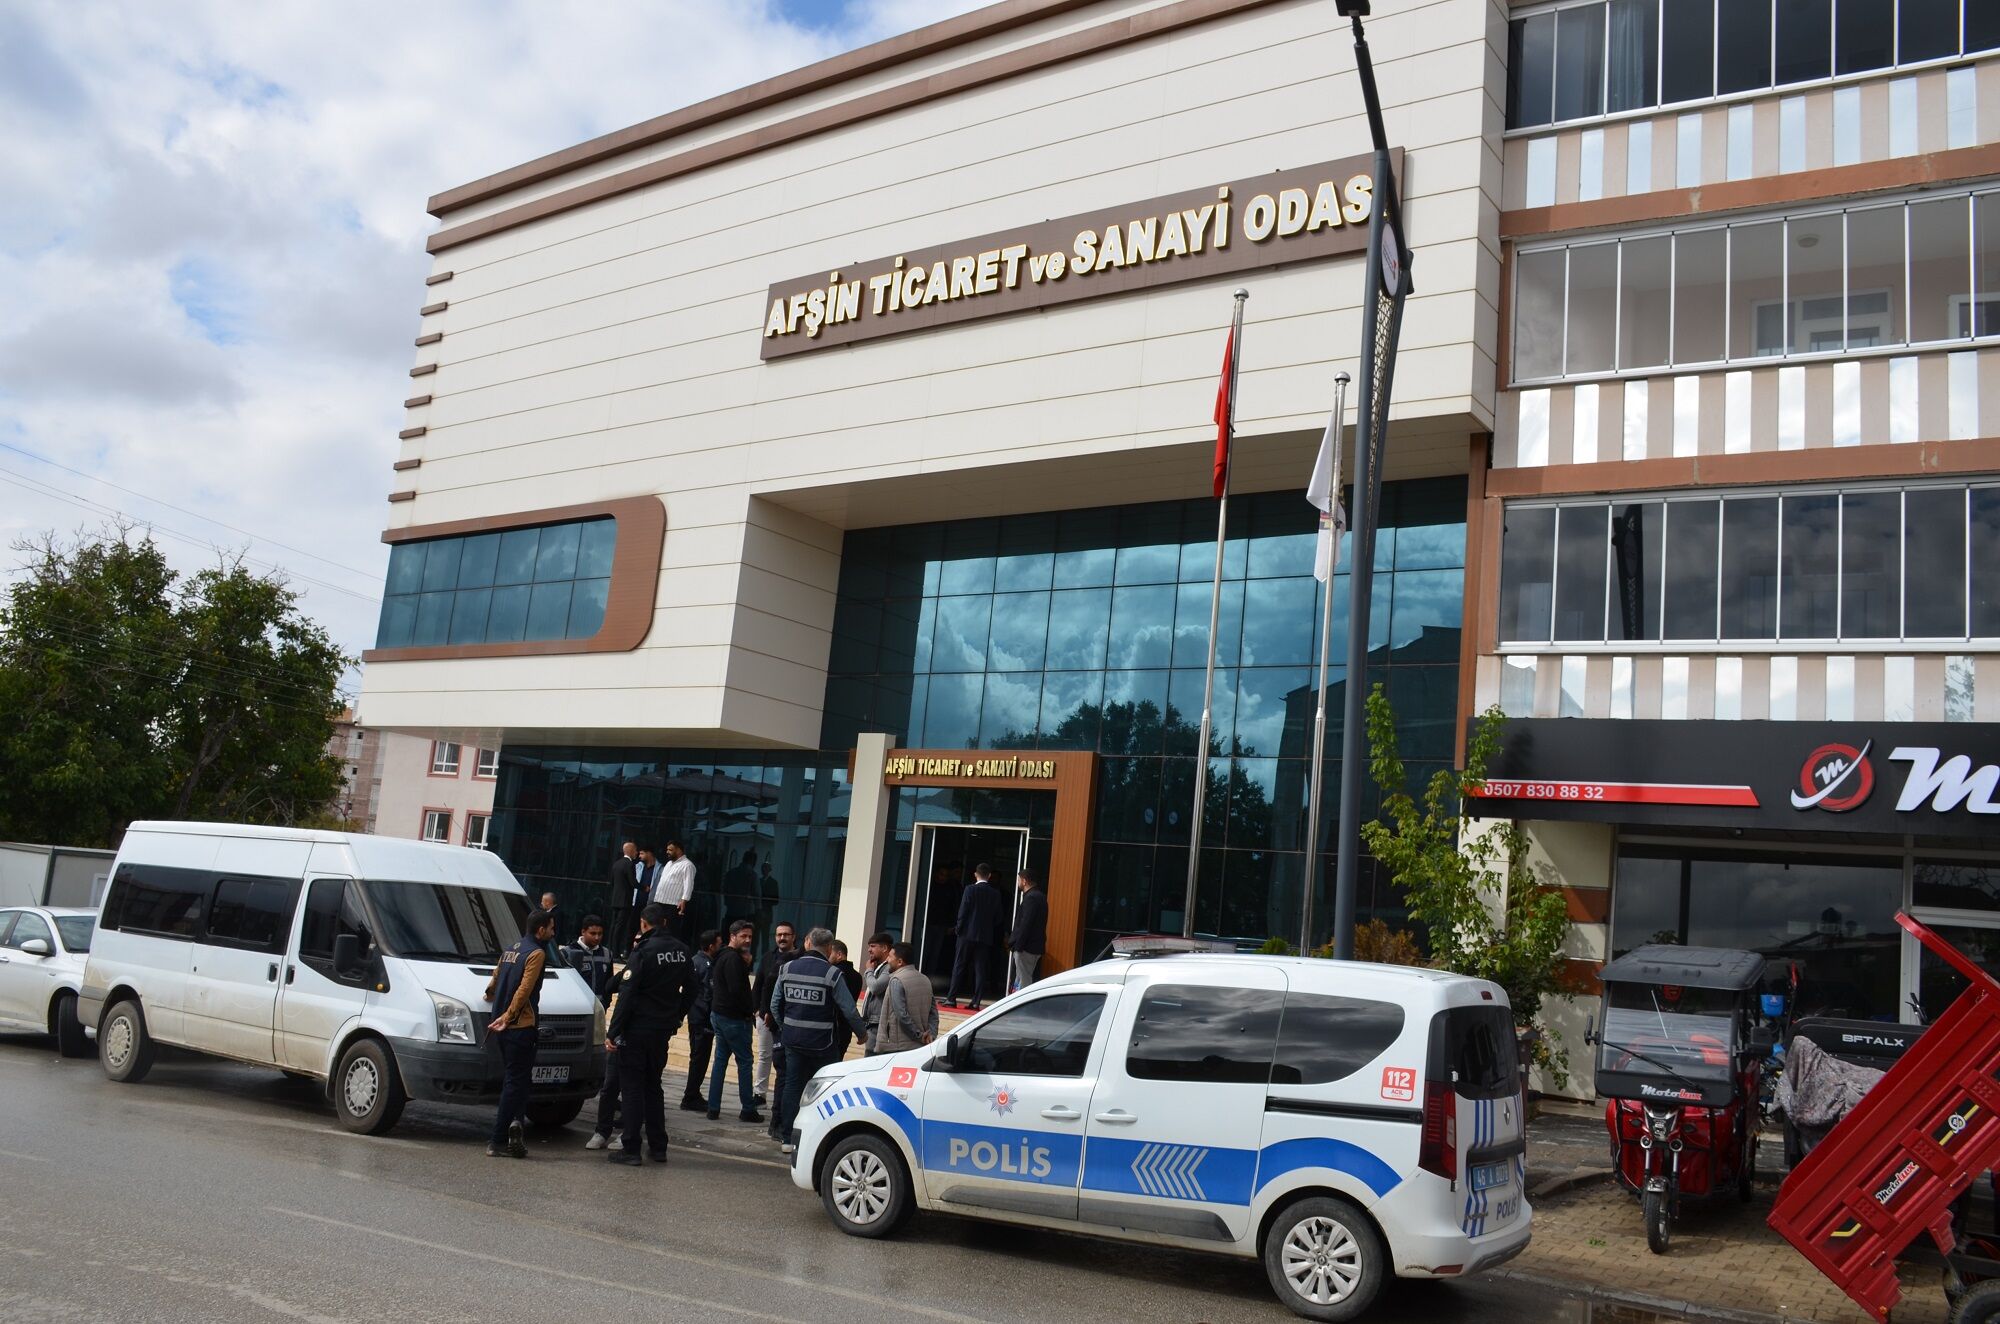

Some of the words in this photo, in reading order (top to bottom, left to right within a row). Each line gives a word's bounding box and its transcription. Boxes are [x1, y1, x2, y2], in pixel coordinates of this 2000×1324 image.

[764, 271, 862, 338] AFŞİN
[869, 243, 1027, 315] TİCARET
[1029, 251, 1066, 283] ve
[1070, 186, 1230, 275] SANAYİ
[1243, 174, 1388, 242] ODAS
[885, 755, 916, 779] AFŞİN
[961, 764, 974, 778] ve
[975, 756, 1017, 778] SANAYİ
[1019, 760, 1055, 778] ODASI
[1484, 783, 1522, 796] 0507
[1526, 784, 1555, 797] 830
[1559, 785, 1579, 798] 88
[1583, 786, 1604, 799] 32
[1842, 1034, 1904, 1047] BFTALX
[535, 1067, 551, 1079] AFH
[553, 1067, 569, 1079] 213
[1388, 1071, 1410, 1087] 112
[949, 1136, 1052, 1178] POLİS
